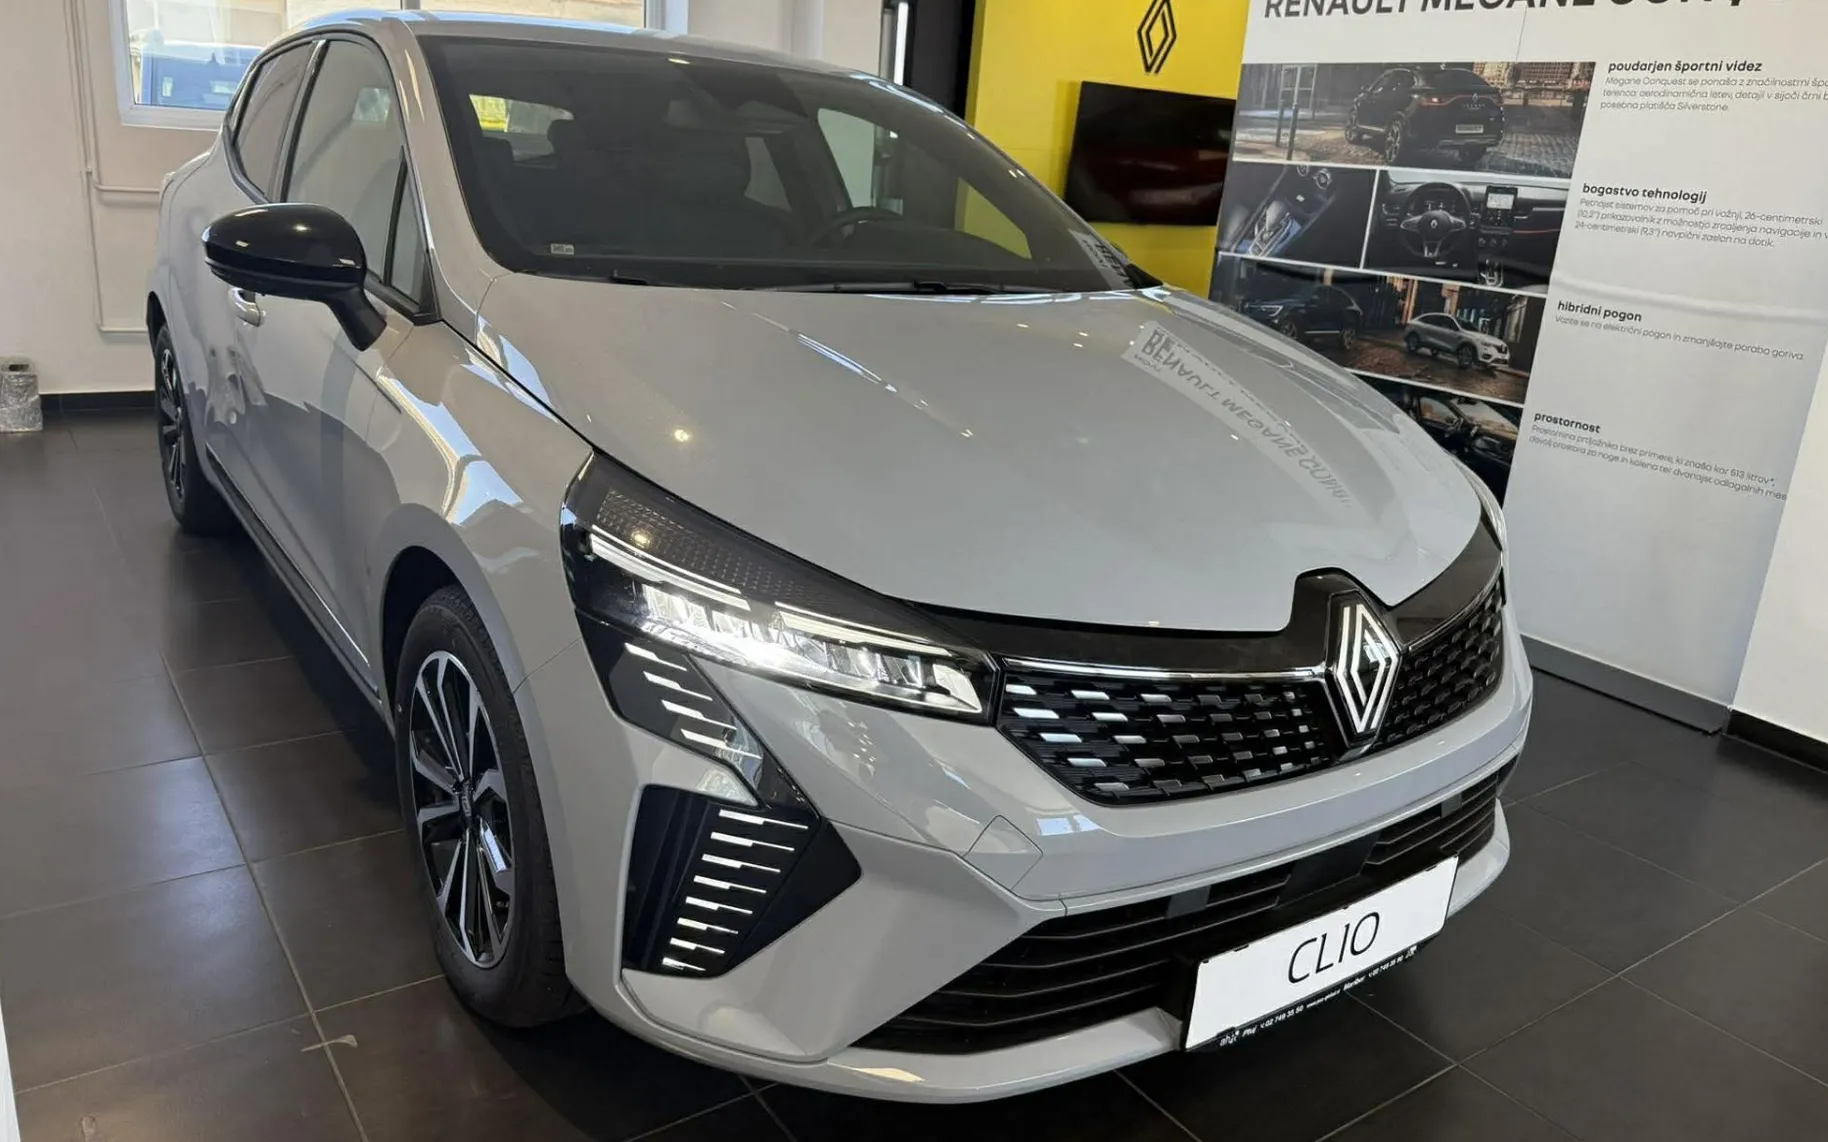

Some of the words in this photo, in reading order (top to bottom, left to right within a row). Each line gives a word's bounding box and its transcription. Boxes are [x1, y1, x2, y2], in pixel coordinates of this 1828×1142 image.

[1607, 60, 1672, 73] poudarjen
[1674, 60, 1723, 73] športni
[1726, 60, 1763, 72] videz
[1643, 77, 1686, 87] Conquest
[1700, 78, 1737, 88] ponaša
[1582, 183, 1639, 197] bogastvo
[1642, 188, 1707, 204] tehnologij
[1667, 205, 1700, 216] pomoč
[1701, 208, 1714, 217] pri
[1759, 226, 1811, 239] navigacije
[1557, 300, 1602, 316] hibridni
[1603, 309, 1642, 322] pogon
[1642, 328, 1671, 340] pogon
[1673, 331, 1681, 341] in
[1734, 342, 1770, 356] porabo
[1533, 412, 1601, 433] prostornost
[1598, 450, 1620, 463] noge
[1619, 444, 1638, 455] brez
[1684, 459, 1712, 472] znaša
[1713, 464, 1728, 475] kar
[1288, 911, 1380, 984] CLIO
